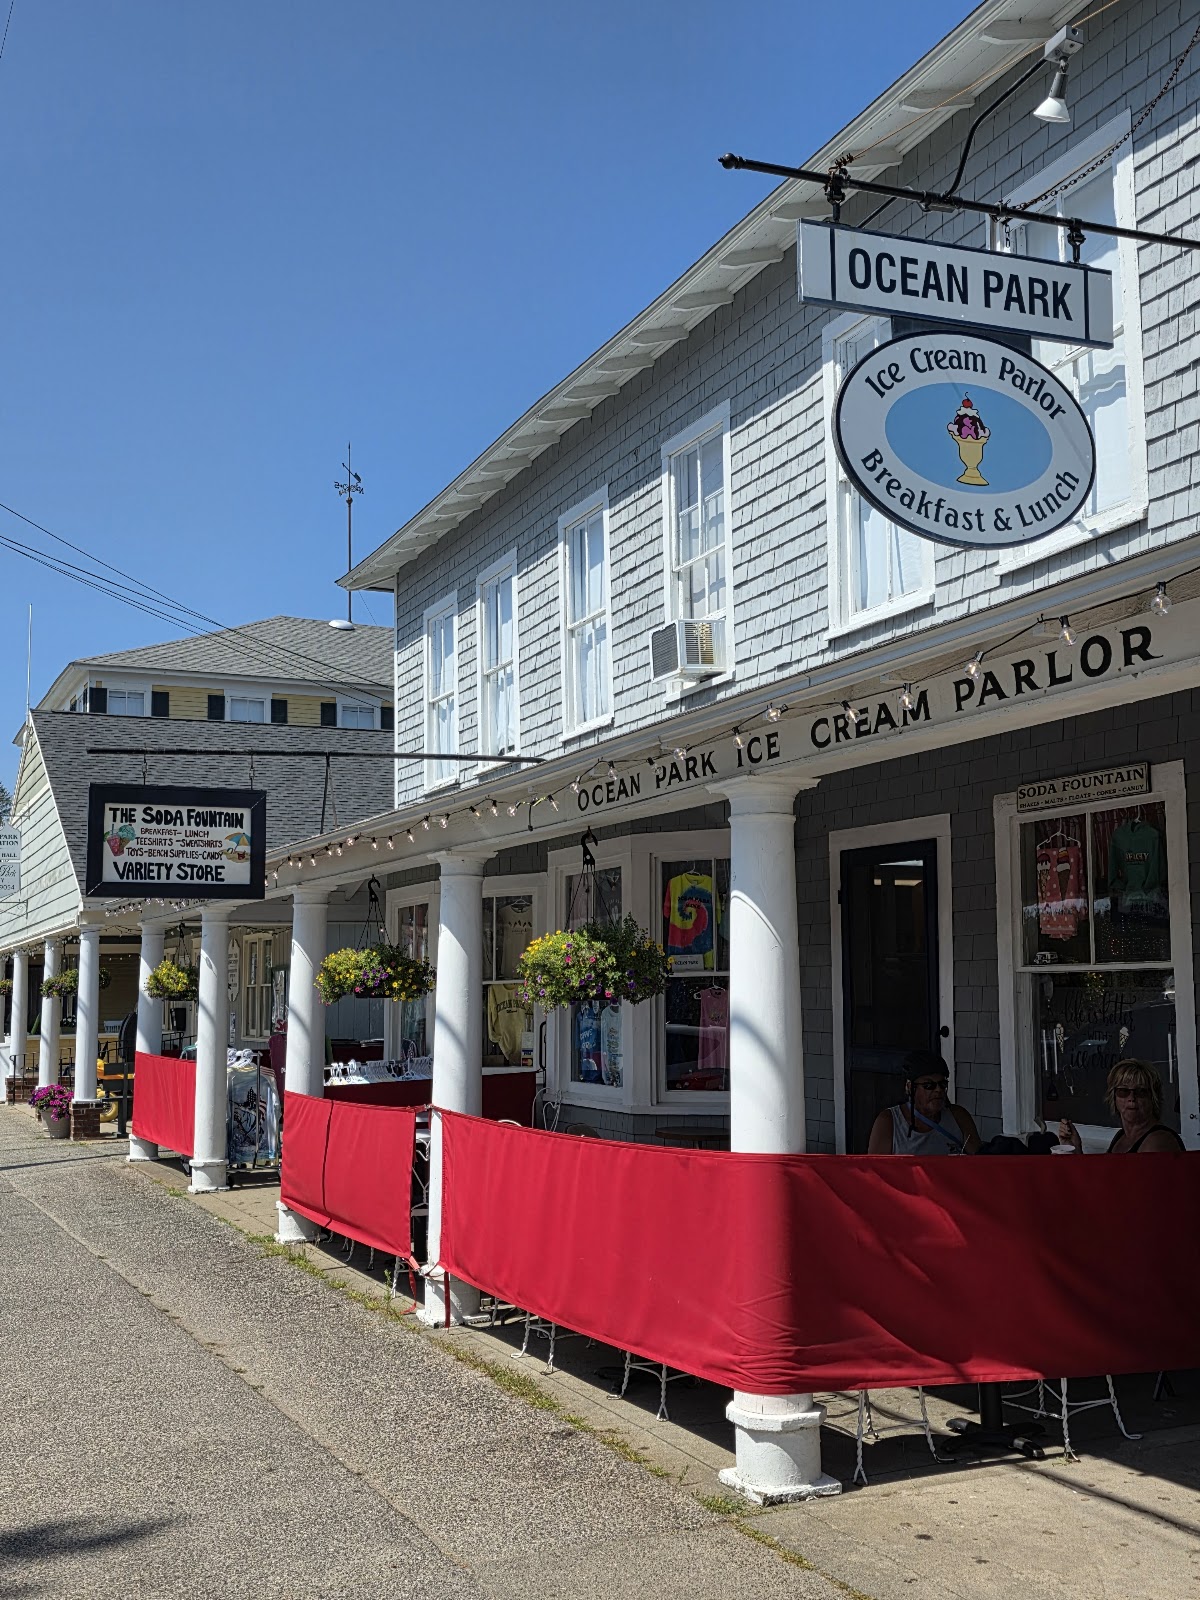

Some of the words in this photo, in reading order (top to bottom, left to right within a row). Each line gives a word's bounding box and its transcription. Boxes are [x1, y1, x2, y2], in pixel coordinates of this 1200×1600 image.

[848, 248, 970, 306] OCEAN
[983, 269, 1073, 322] PARK
[865, 362, 906, 399] Ice
[910, 347, 987, 374] Cream
[999, 356, 1067, 420] Parlor
[861, 448, 985, 532] Breakfast
[993, 509, 1012, 531] &
[1015, 468, 1080, 528] Lunch
[577, 771, 641, 811] OCEAN
[654, 751, 719, 789] PARK
[736, 731, 780, 768] ICE
[810, 701, 933, 749] CREAM
[954, 625, 1164, 712] PARLOR
[1018, 783, 1057, 799] SODA
[1062, 768, 1144, 791] FOUNTAIN
[109, 807, 137, 823] THE
[141, 806, 184, 827] SODA
[187, 809, 244, 829] FOUNTAIN
[136, 837, 173, 846] TEESHIRTS
[185, 829, 209, 838] LUNCH
[113, 861, 173, 881] VARIETY
[176, 864, 225, 882] STORE
